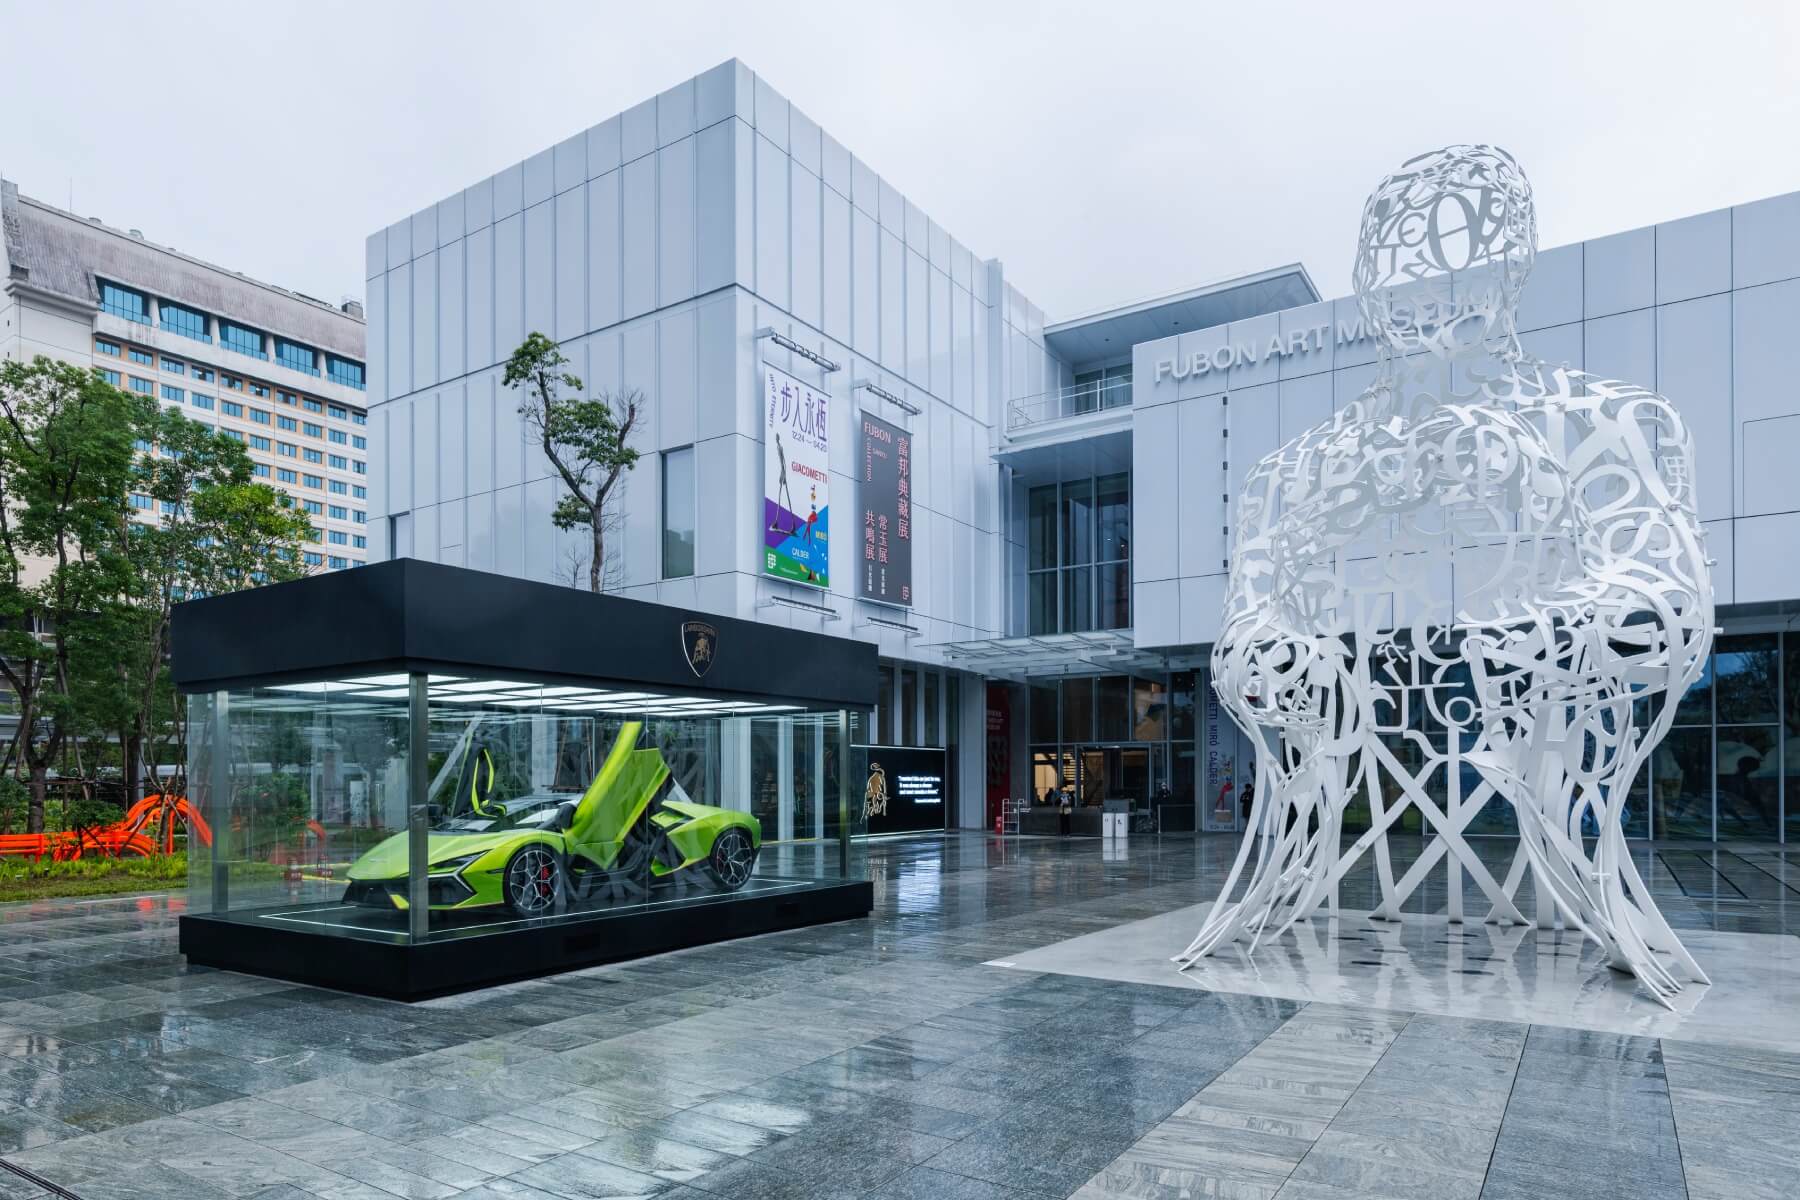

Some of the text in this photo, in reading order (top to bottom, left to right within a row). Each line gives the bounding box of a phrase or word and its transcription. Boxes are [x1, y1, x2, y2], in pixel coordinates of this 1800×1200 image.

[1154, 342, 1257, 383] FUBON
[1264, 326, 1330, 362] ART
[864, 421, 892, 444] FUBON
[791, 461, 827, 484] GIACOMETTI
[1208, 751, 1218, 785] CALDER
